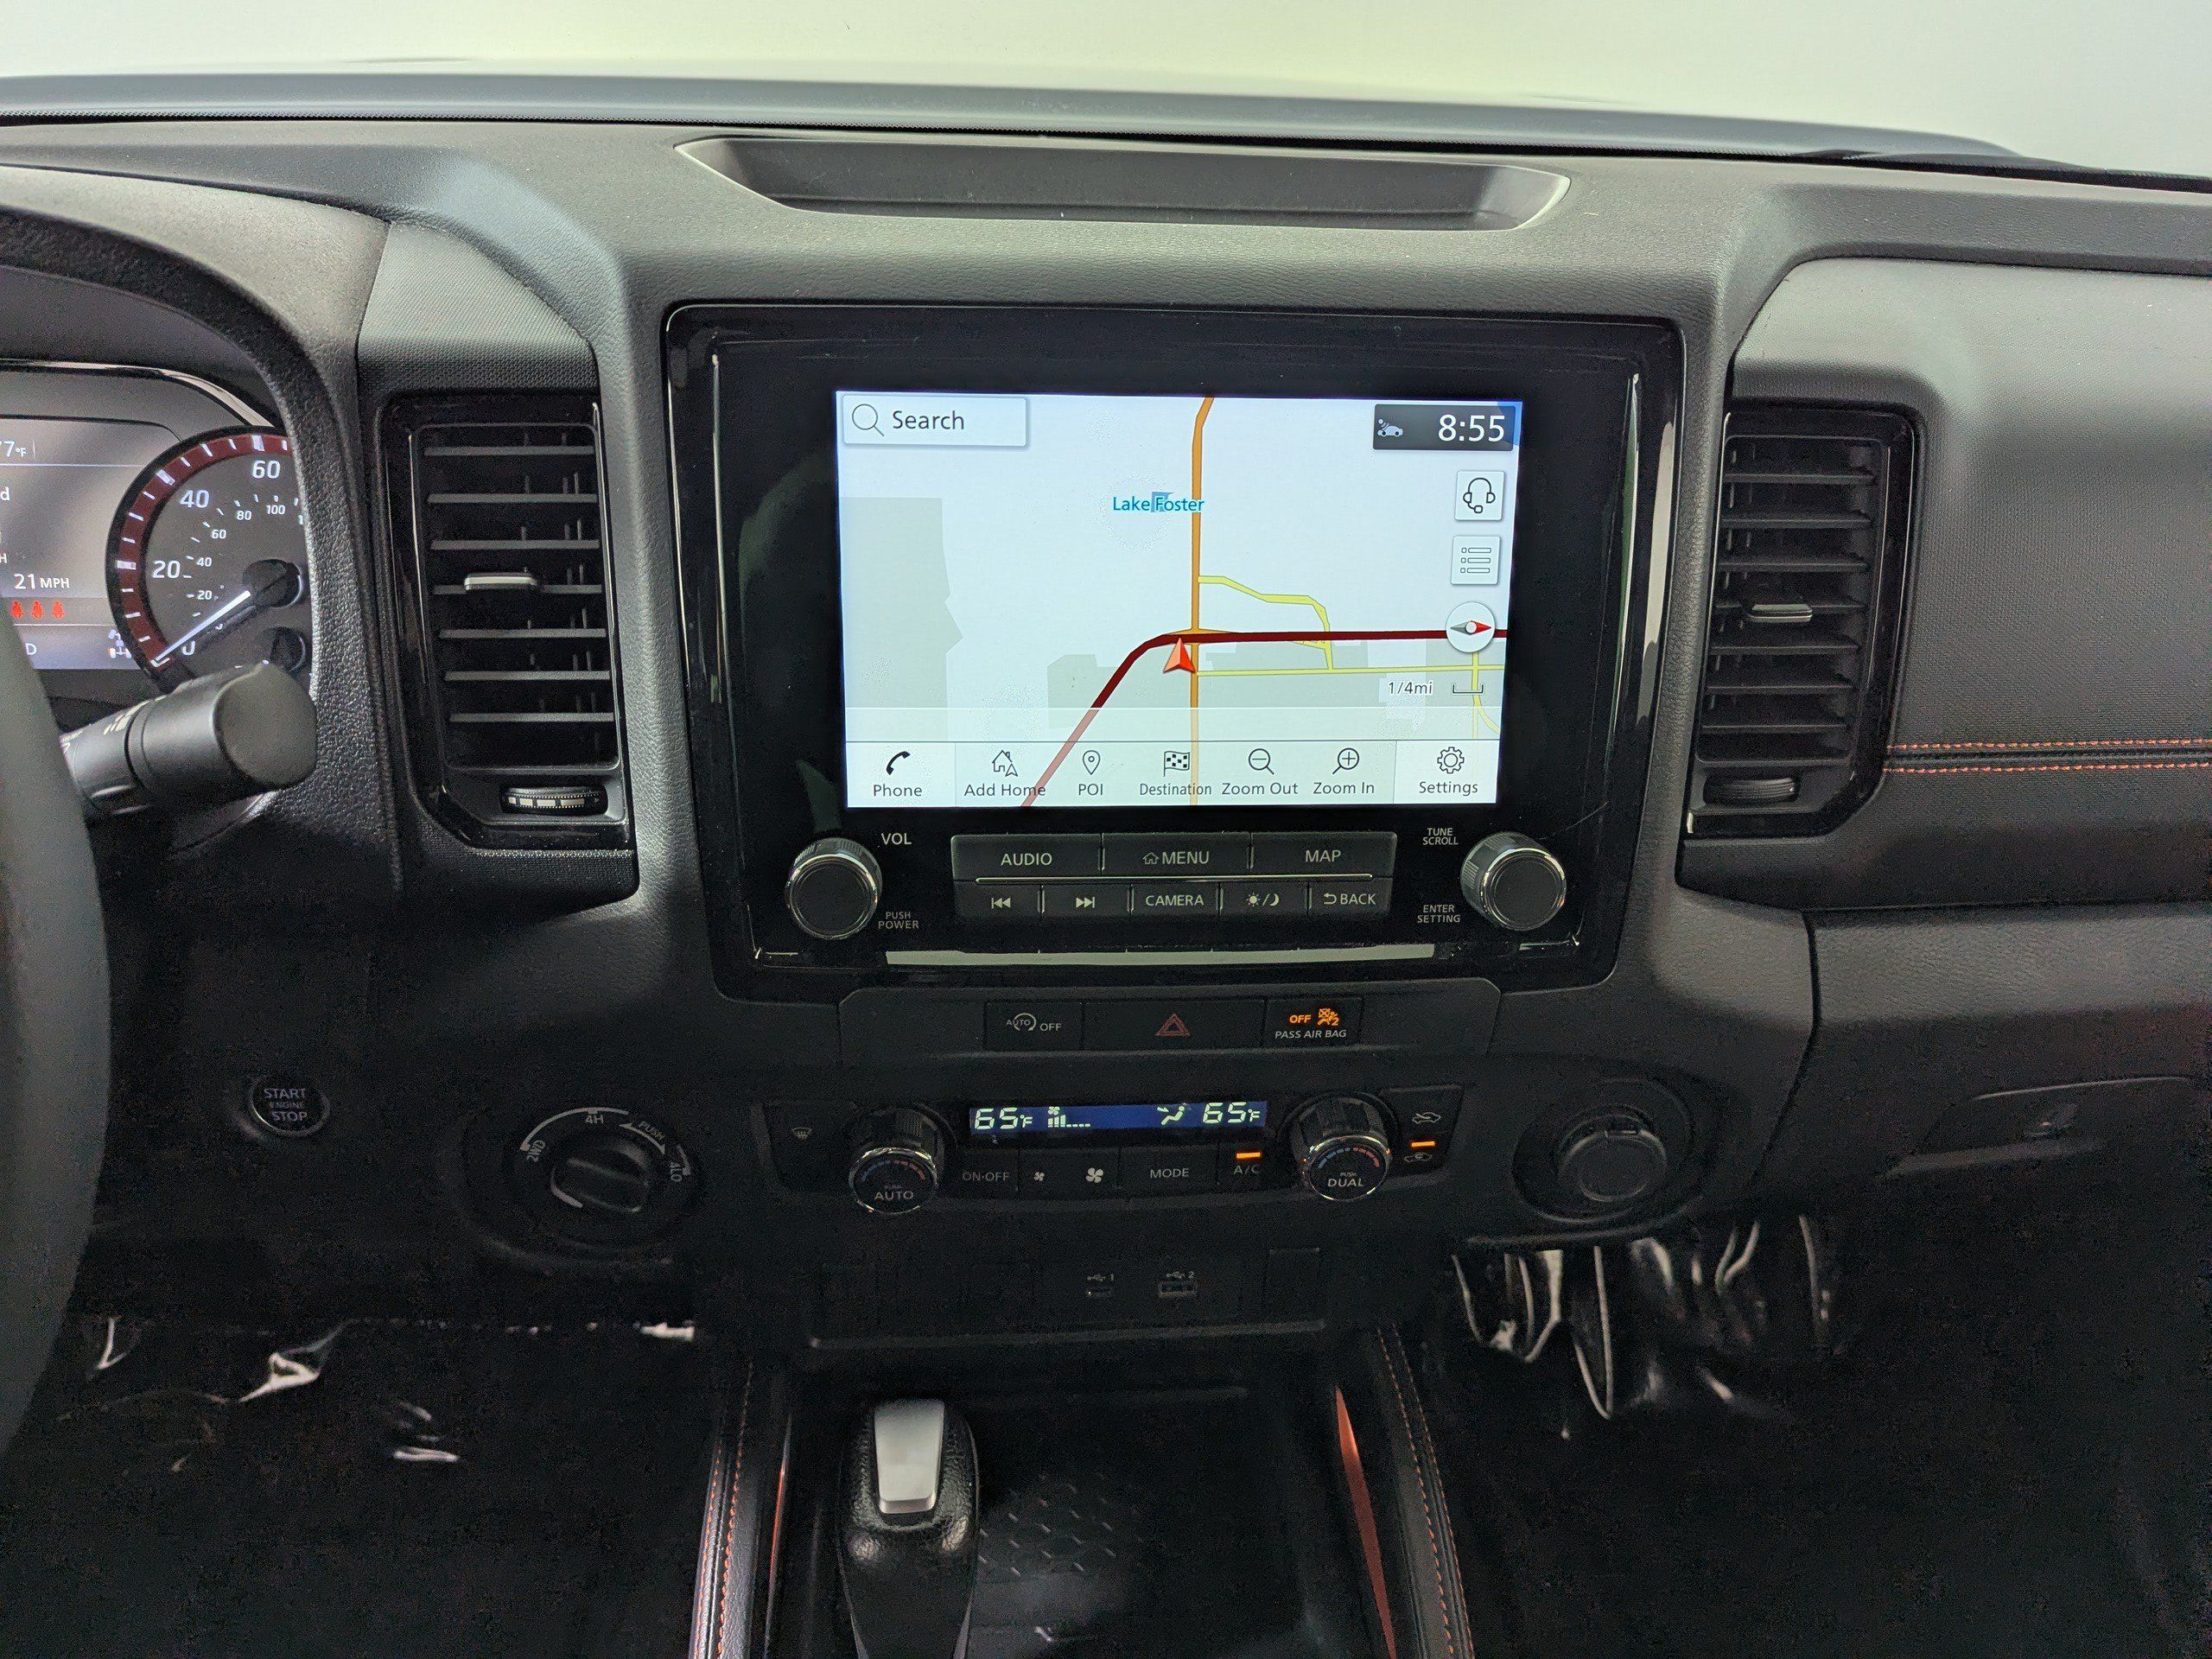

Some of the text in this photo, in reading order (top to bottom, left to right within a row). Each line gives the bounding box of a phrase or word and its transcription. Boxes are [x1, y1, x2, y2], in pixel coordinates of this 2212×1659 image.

[892, 410, 965, 431] Search
[1438, 414, 1506, 442] 8:55
[252, 460, 281, 480] 60
[180, 489, 210, 509] 40
[1113, 495, 1205, 512] Lake Foster
[236, 510, 252, 521] 80
[266, 505, 286, 515] 100
[211, 529, 227, 540] 60
[196, 556, 213, 568] 40
[152, 560, 181, 579] 20
[14, 574, 70, 589] 21 MPH
[197, 589, 213, 601] 20
[26, 643, 38, 657] D
[1388, 681, 1433, 696] 1/4mi
[874, 784, 923, 798] Phone
[963, 784, 1047, 797] Add Home
[1078, 784, 1104, 797] POI
[1139, 783, 1212, 796] Destination
[1222, 782, 1299, 795] Zoom Out
[1313, 782, 1376, 795] Zoom In
[1418, 781, 1479, 797] Settings
[1426, 828, 1454, 836] TUNE
[880, 833, 912, 846] VOL
[1422, 836, 1459, 846] SCROLL
[1001, 852, 1052, 866] AUDIO
[1162, 851, 1210, 865] MENU
[1305, 849, 1342, 863] MAP
[1145, 894, 1205, 907] CAMERA
[1339, 893, 1376, 906] BACK
[885, 911, 912, 919] PUSH
[1422, 904, 1455, 913] ENTER
[878, 920, 920, 930] POWER
[1417, 913, 1461, 924] SETTING
[1289, 1014, 1312, 1024] OFF
[1039, 1022, 1063, 1032] OFF
[1274, 1029, 1347, 1039] PASS AIR BAG
[263, 1088, 306, 1099] START
[271, 1111, 308, 1122] STOP
[585, 1114, 604, 1124] 4H
[525, 1140, 546, 1163] 2WD
[1149, 1167, 1190, 1179] MODE
[1233, 1165, 1261, 1175] A/C
[1327, 1177, 1364, 1187] DUAL
[874, 1191, 914, 1201] AUTO
